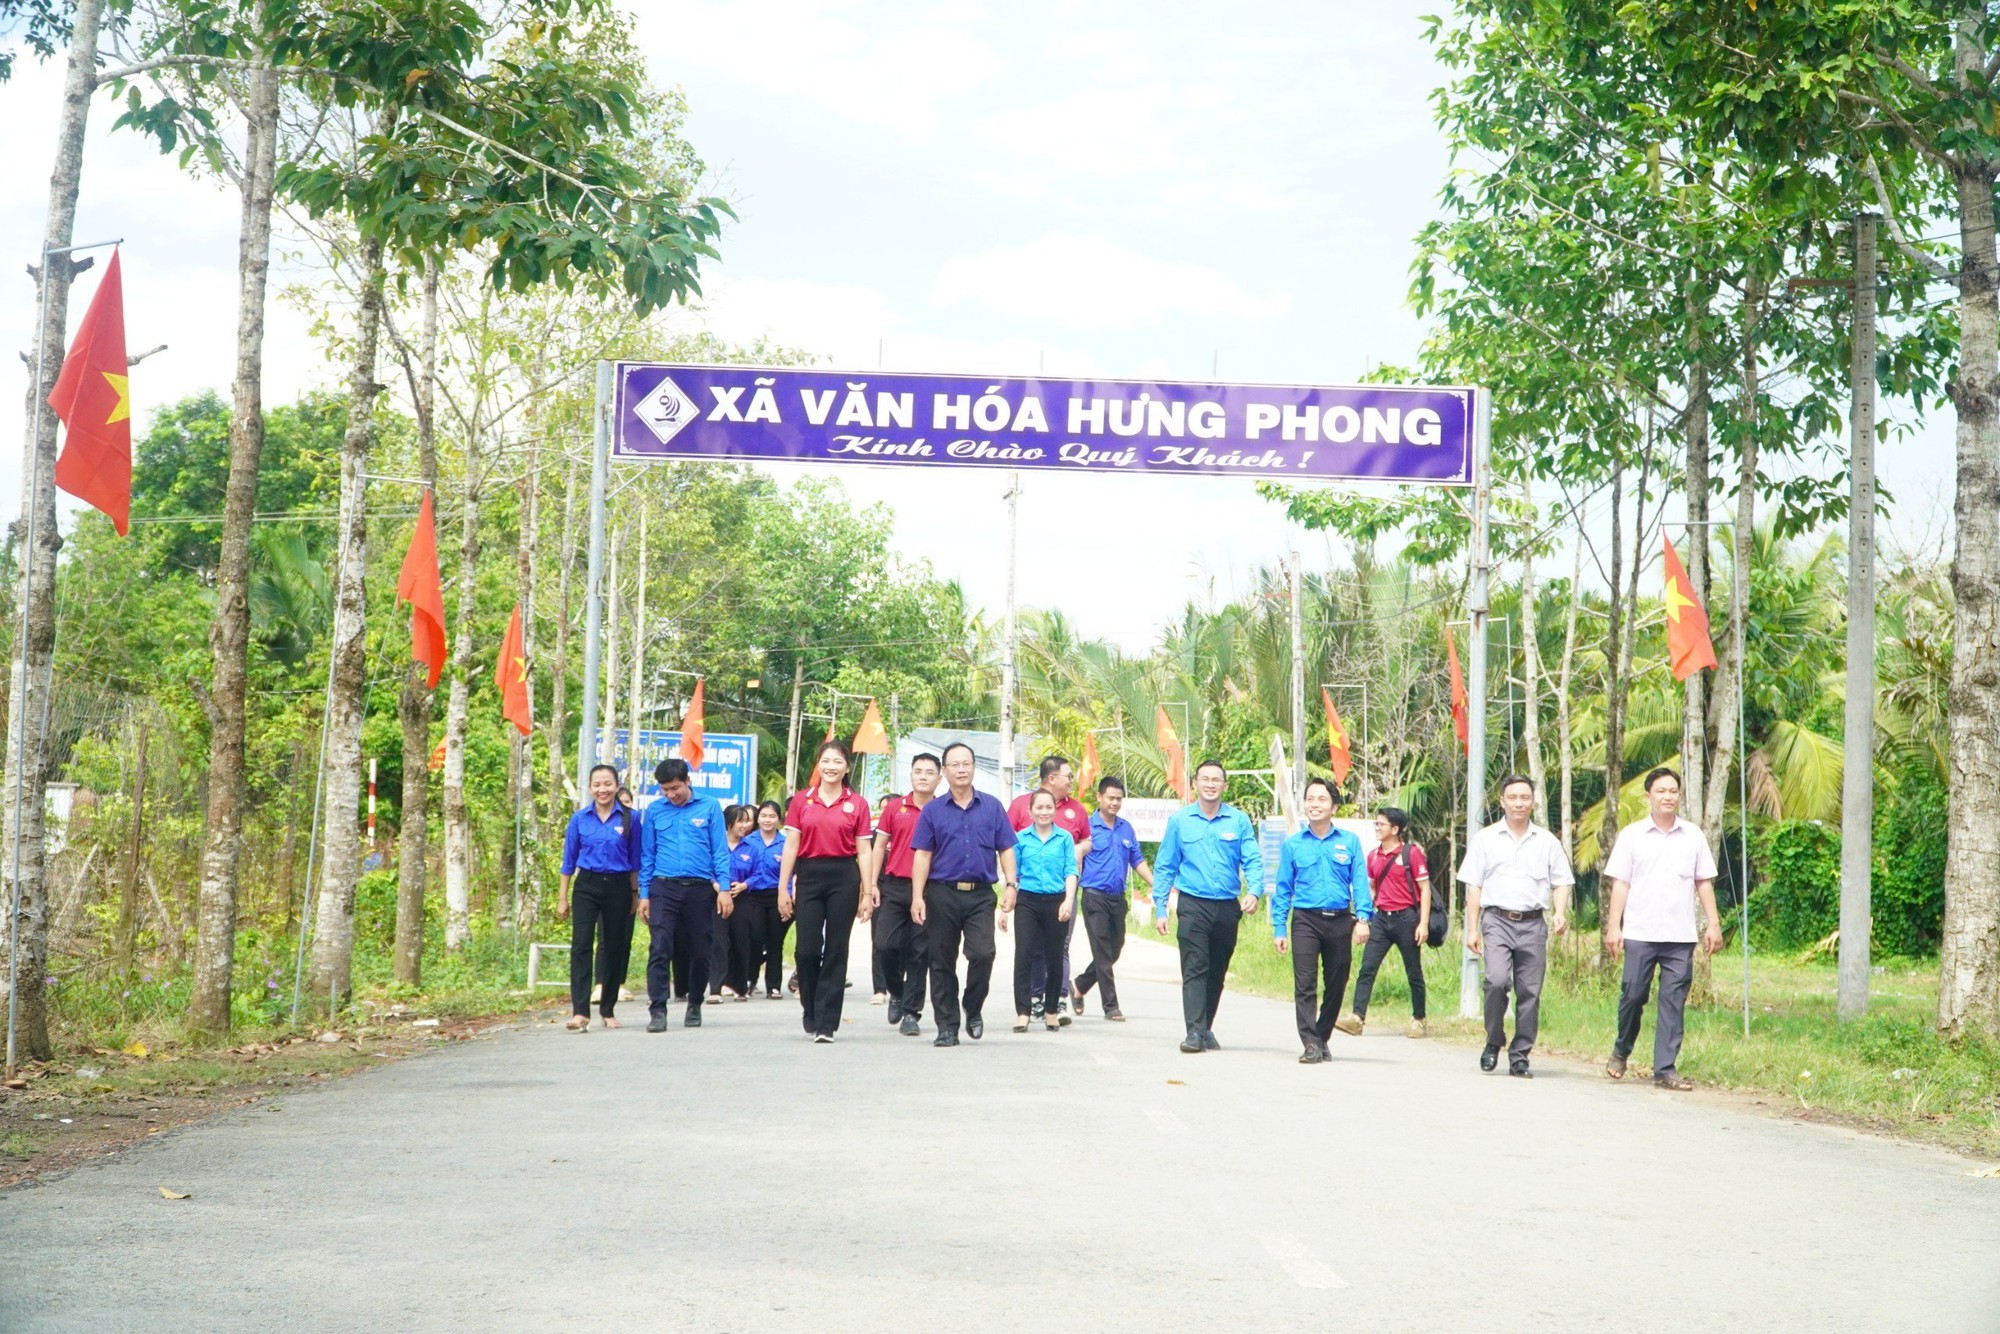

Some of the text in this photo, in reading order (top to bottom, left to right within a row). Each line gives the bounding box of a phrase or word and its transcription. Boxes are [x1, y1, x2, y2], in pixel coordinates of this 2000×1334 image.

[706, 376, 1442, 447] XÃ VĂN HÓA HƯNG PHONG
[827, 434, 1314, 469] Kính Chào Quý Khách !
